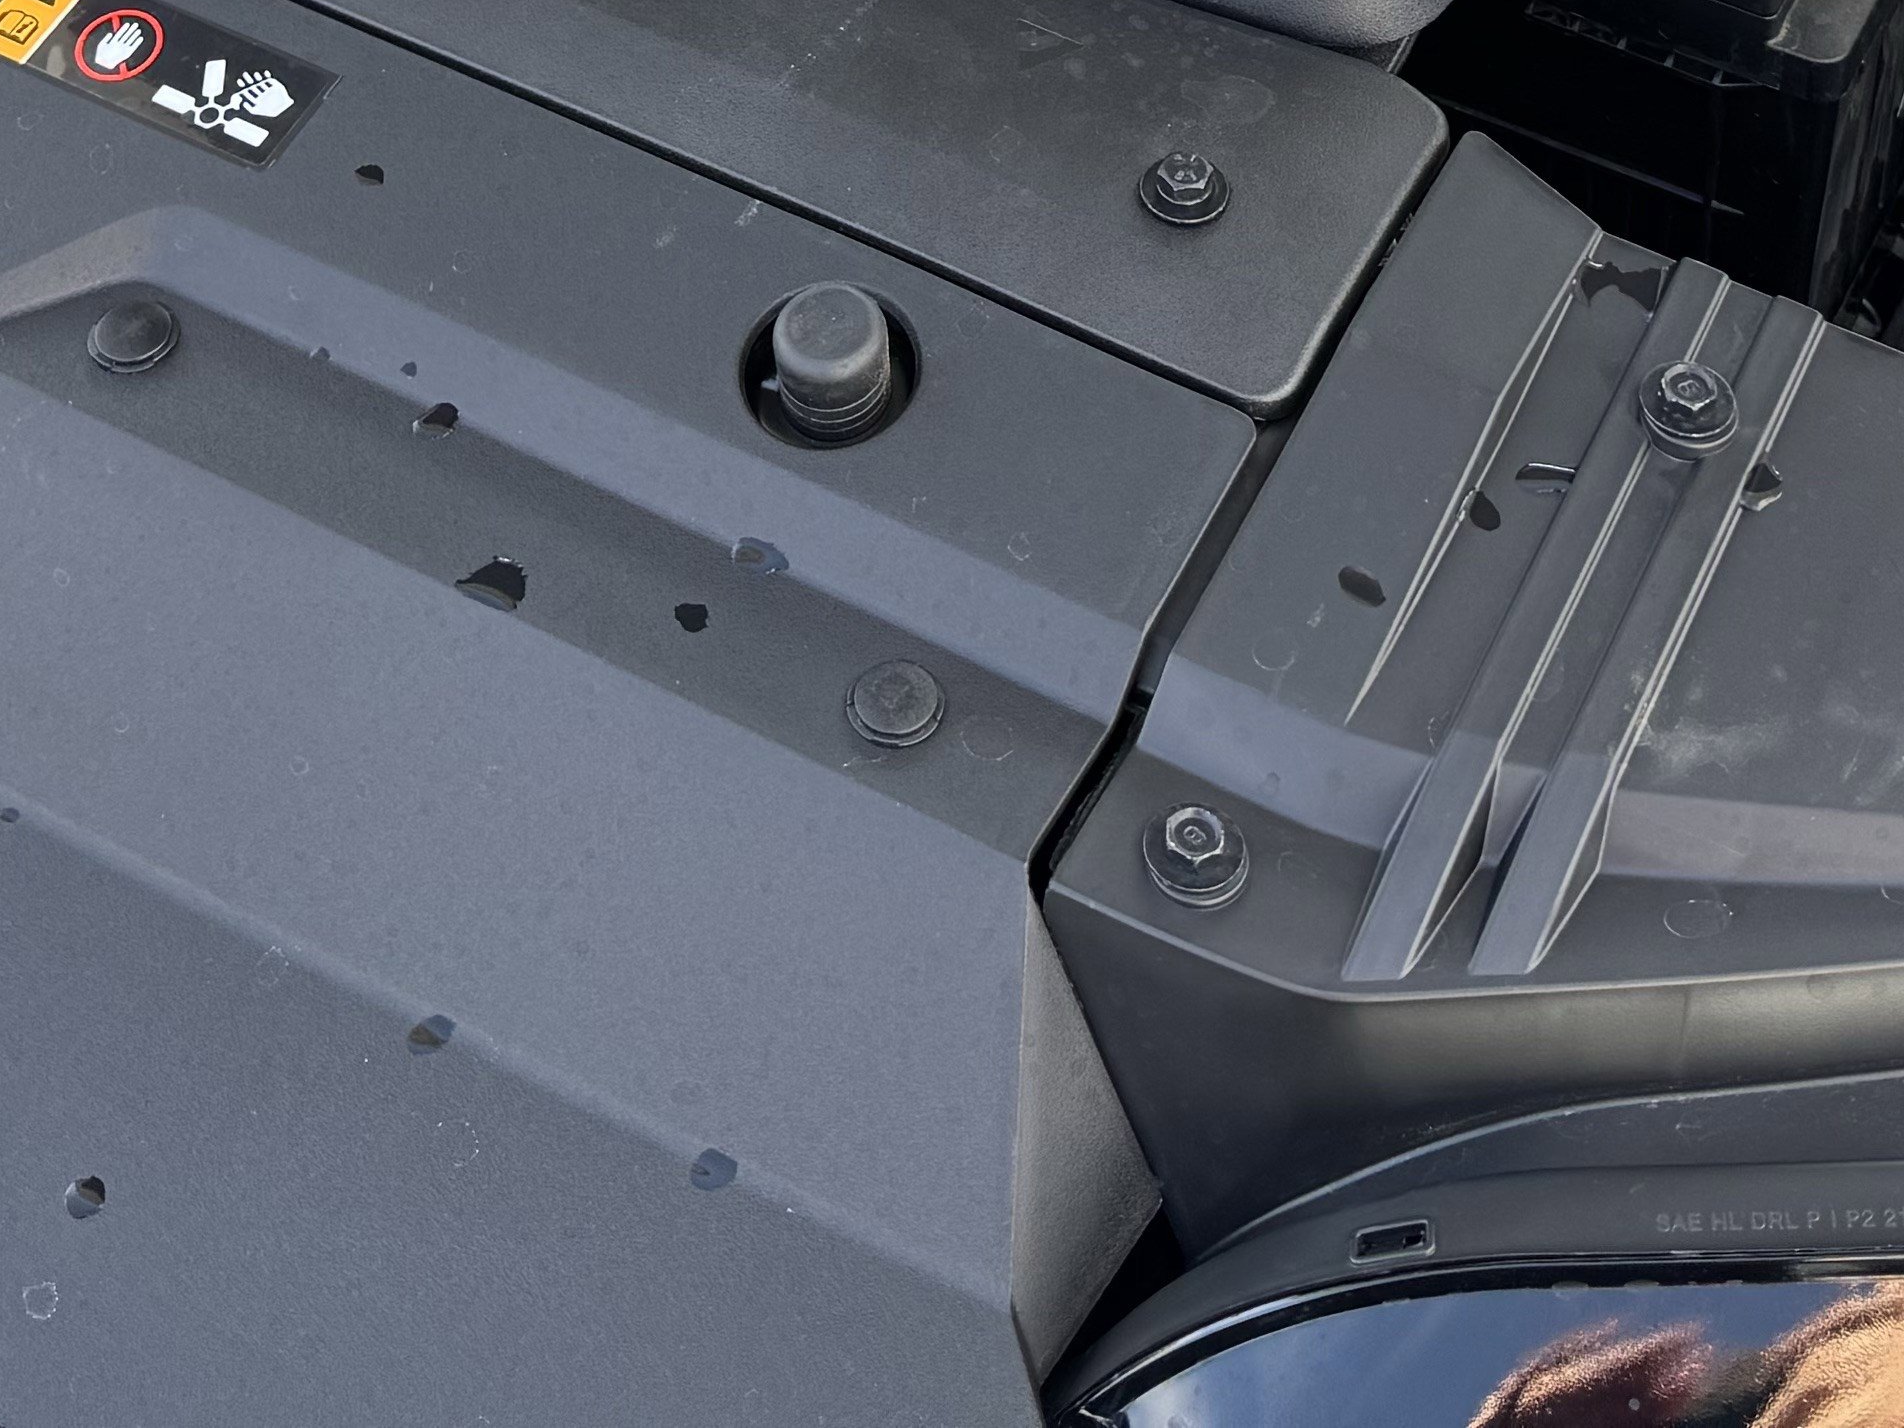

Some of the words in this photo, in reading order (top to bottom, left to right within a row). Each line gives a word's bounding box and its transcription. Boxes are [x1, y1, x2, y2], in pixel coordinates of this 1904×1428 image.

[1655, 1211, 1704, 1233] SAE
[1711, 1211, 1744, 1232] HL
[1751, 1210, 1799, 1231] DRL
[1807, 1210, 1821, 1229] P
[1847, 1208, 1877, 1229] P2
